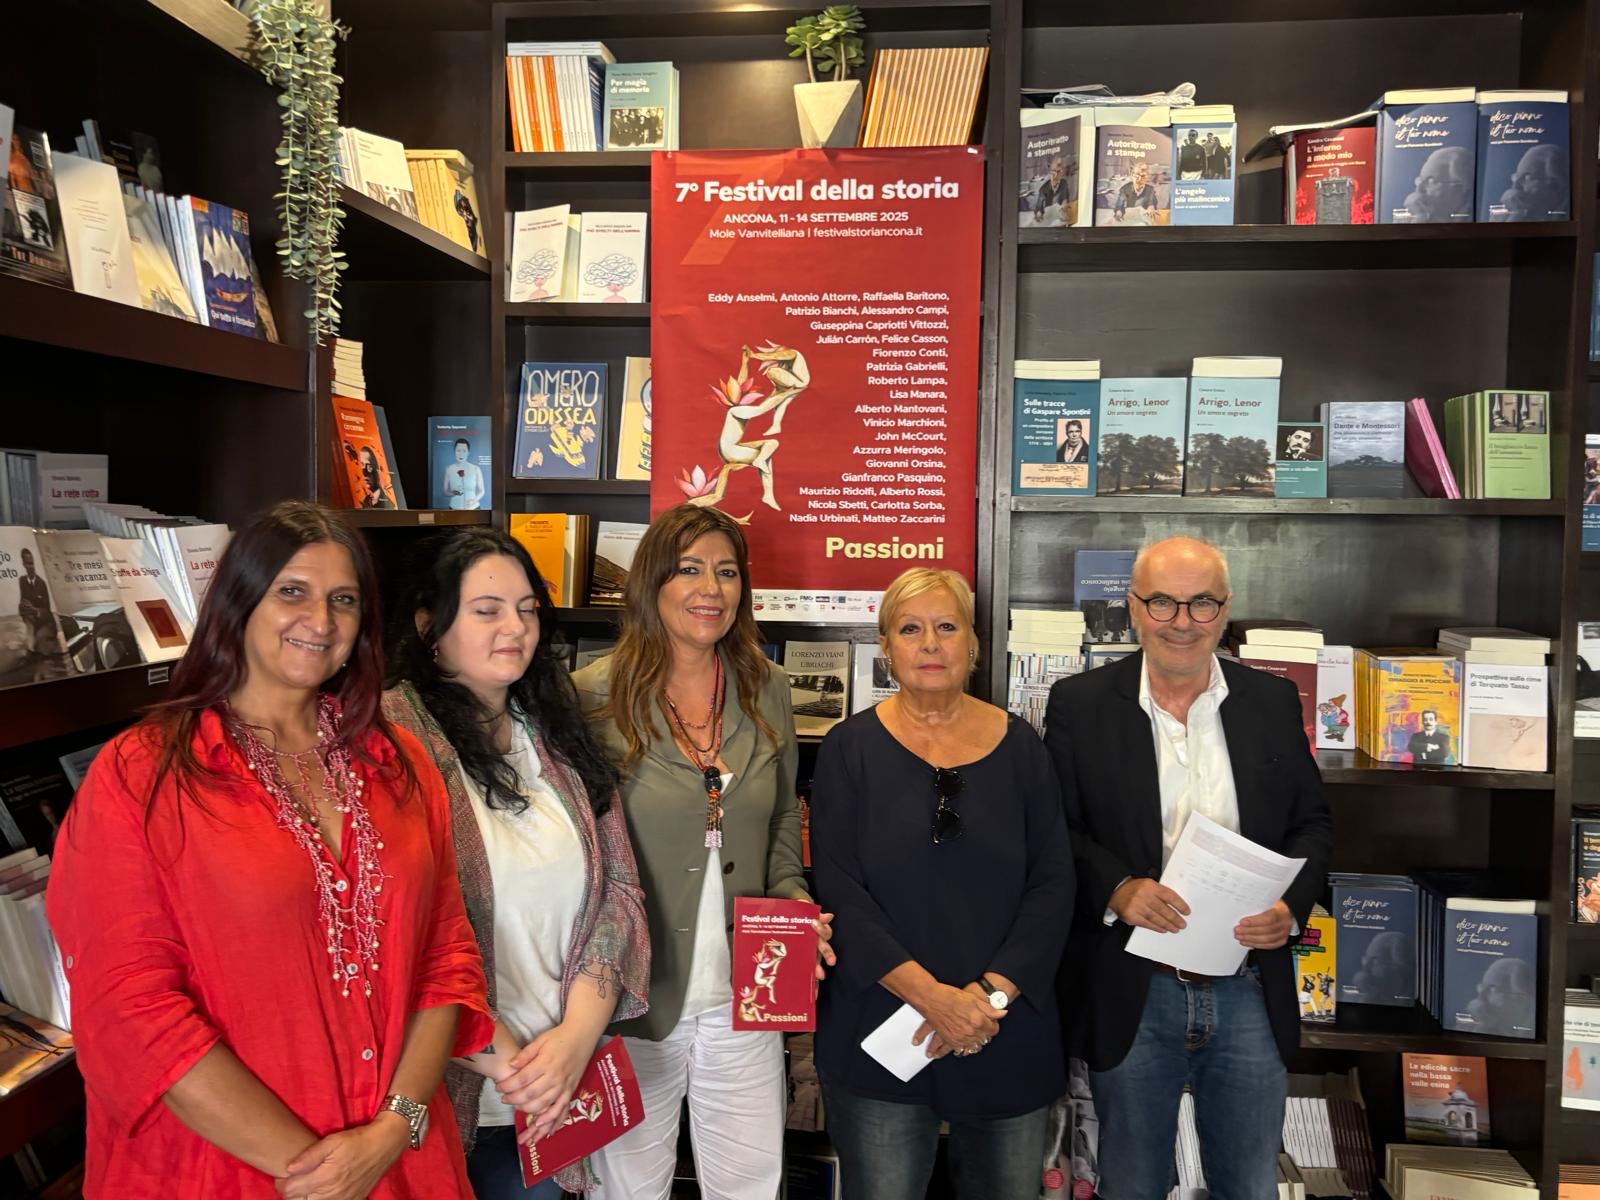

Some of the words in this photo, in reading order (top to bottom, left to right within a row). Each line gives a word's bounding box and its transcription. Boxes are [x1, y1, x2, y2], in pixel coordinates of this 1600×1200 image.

[624, 78, 647, 88] magia
[610, 86, 617, 94] di
[1027, 136, 1069, 150] Autoritratto
[1107, 139, 1157, 151] Autoritratto
[1034, 146, 1060, 158] stampa
[1114, 149, 1146, 158] stampa
[1313, 152, 1336, 161] modo
[1337, 151, 1353, 159] mio
[675, 182, 699, 202] 7°
[704, 179, 803, 202] Festival
[810, 179, 874, 201] della
[881, 176, 959, 199] storia
[723, 213, 777, 224] ANCONA,
[810, 212, 878, 222] SETTEMBRE
[880, 212, 909, 221] 2025
[709, 229, 736, 238] Mole
[737, 228, 805, 238] Vanvitelliana
[813, 227, 923, 237] festivalstoriancona.it
[708, 293, 734, 304] Eddy
[736, 293, 778, 302] Anselmi,
[780, 293, 819, 302] Antonio
[821, 293, 861, 302] Attorre,
[863, 292, 904, 301] Raffaella
[906, 291, 949, 301] Baritono,
[785, 306, 821, 315] Patrizio
[822, 306, 859, 316] Bianchi,
[861, 306, 914, 315] Alessandro
[916, 305, 949, 316] Campi,
[810, 321, 864, 331] Giuseppina
[865, 320, 907, 331] Capriotti
[909, 319, 949, 329] Vittozzi,
[816, 335, 844, 344] Julián
[845, 335, 880, 344] Carrón,
[881, 334, 910, 343] Felice
[911, 334, 949, 344] Casson,
[873, 348, 917, 357] Fiorenzo
[919, 348, 948, 357] Conti,
[866, 362, 903, 371] Patrizia
[905, 362, 948, 371] Gabrielli,
[868, 376, 909, 385] Roberto
[911, 376, 948, 386] Lampa,
[526, 370, 600, 408] OMERO
[890, 390, 909, 399] Lisa
[910, 390, 947, 399] Manara,
[1024, 398, 1042, 406] Sulle
[1108, 398, 1140, 408] Arrigo,
[1144, 398, 1170, 406] Lenor
[1198, 397, 1232, 408] Arrigo,
[1235, 398, 1262, 407] Lenor
[855, 405, 892, 413] Alberto
[893, 404, 947, 413] Mantovani,
[1032, 408, 1061, 416] Gaspare
[1062, 408, 1091, 416] Spontini
[524, 407, 597, 425] ODISSEA
[863, 418, 896, 427] Vinicio
[897, 418, 947, 427] Marchioni,
[875, 432, 899, 440] John
[901, 432, 947, 441] McCourt,
[853, 446, 891, 454] Azzurra
[894, 445, 946, 456] Meringolo,
[865, 459, 909, 468] Giovanni
[911, 459, 946, 469] Orsina,
[841, 473, 895, 482] Gianfranco
[897, 473, 946, 484] Pasquino,
[52, 488, 62, 498] La
[64, 489, 80, 498] rete
[82, 489, 100, 498] rotta
[799, 487, 841, 495] Maurizio
[843, 487, 877, 496] Ridolfi,
[879, 487, 916, 496] Alberto
[917, 487, 945, 497] Rossi,
[808, 500, 837, 509] Nicola
[839, 501, 869, 510] Sbetti,
[870, 501, 910, 509] Carlotta
[913, 501, 945, 510] Sorba,
[790, 514, 818, 522] Nadia
[820, 514, 861, 523] Urbinati,
[863, 514, 898, 523] Matteo
[900, 514, 945, 523] Zaccarini
[826, 536, 944, 559] Passioni
[84, 560, 105, 569] mesi
[190, 561, 200, 570] La
[200, 559, 215, 569] rete
[74, 573, 108, 582] vacanza
[131, 568, 142, 577] da
[742, 915, 770, 923] Festival
[790, 916, 813, 924] storia
[763, 1013, 807, 1022] Passioni
[605, 1053, 621, 1087] Festival
[1409, 1062, 1418, 1070] Le
[1420, 1064, 1448, 1072] edicole
[616, 1085, 625, 1105] della
[620, 1104, 629, 1127] storia
